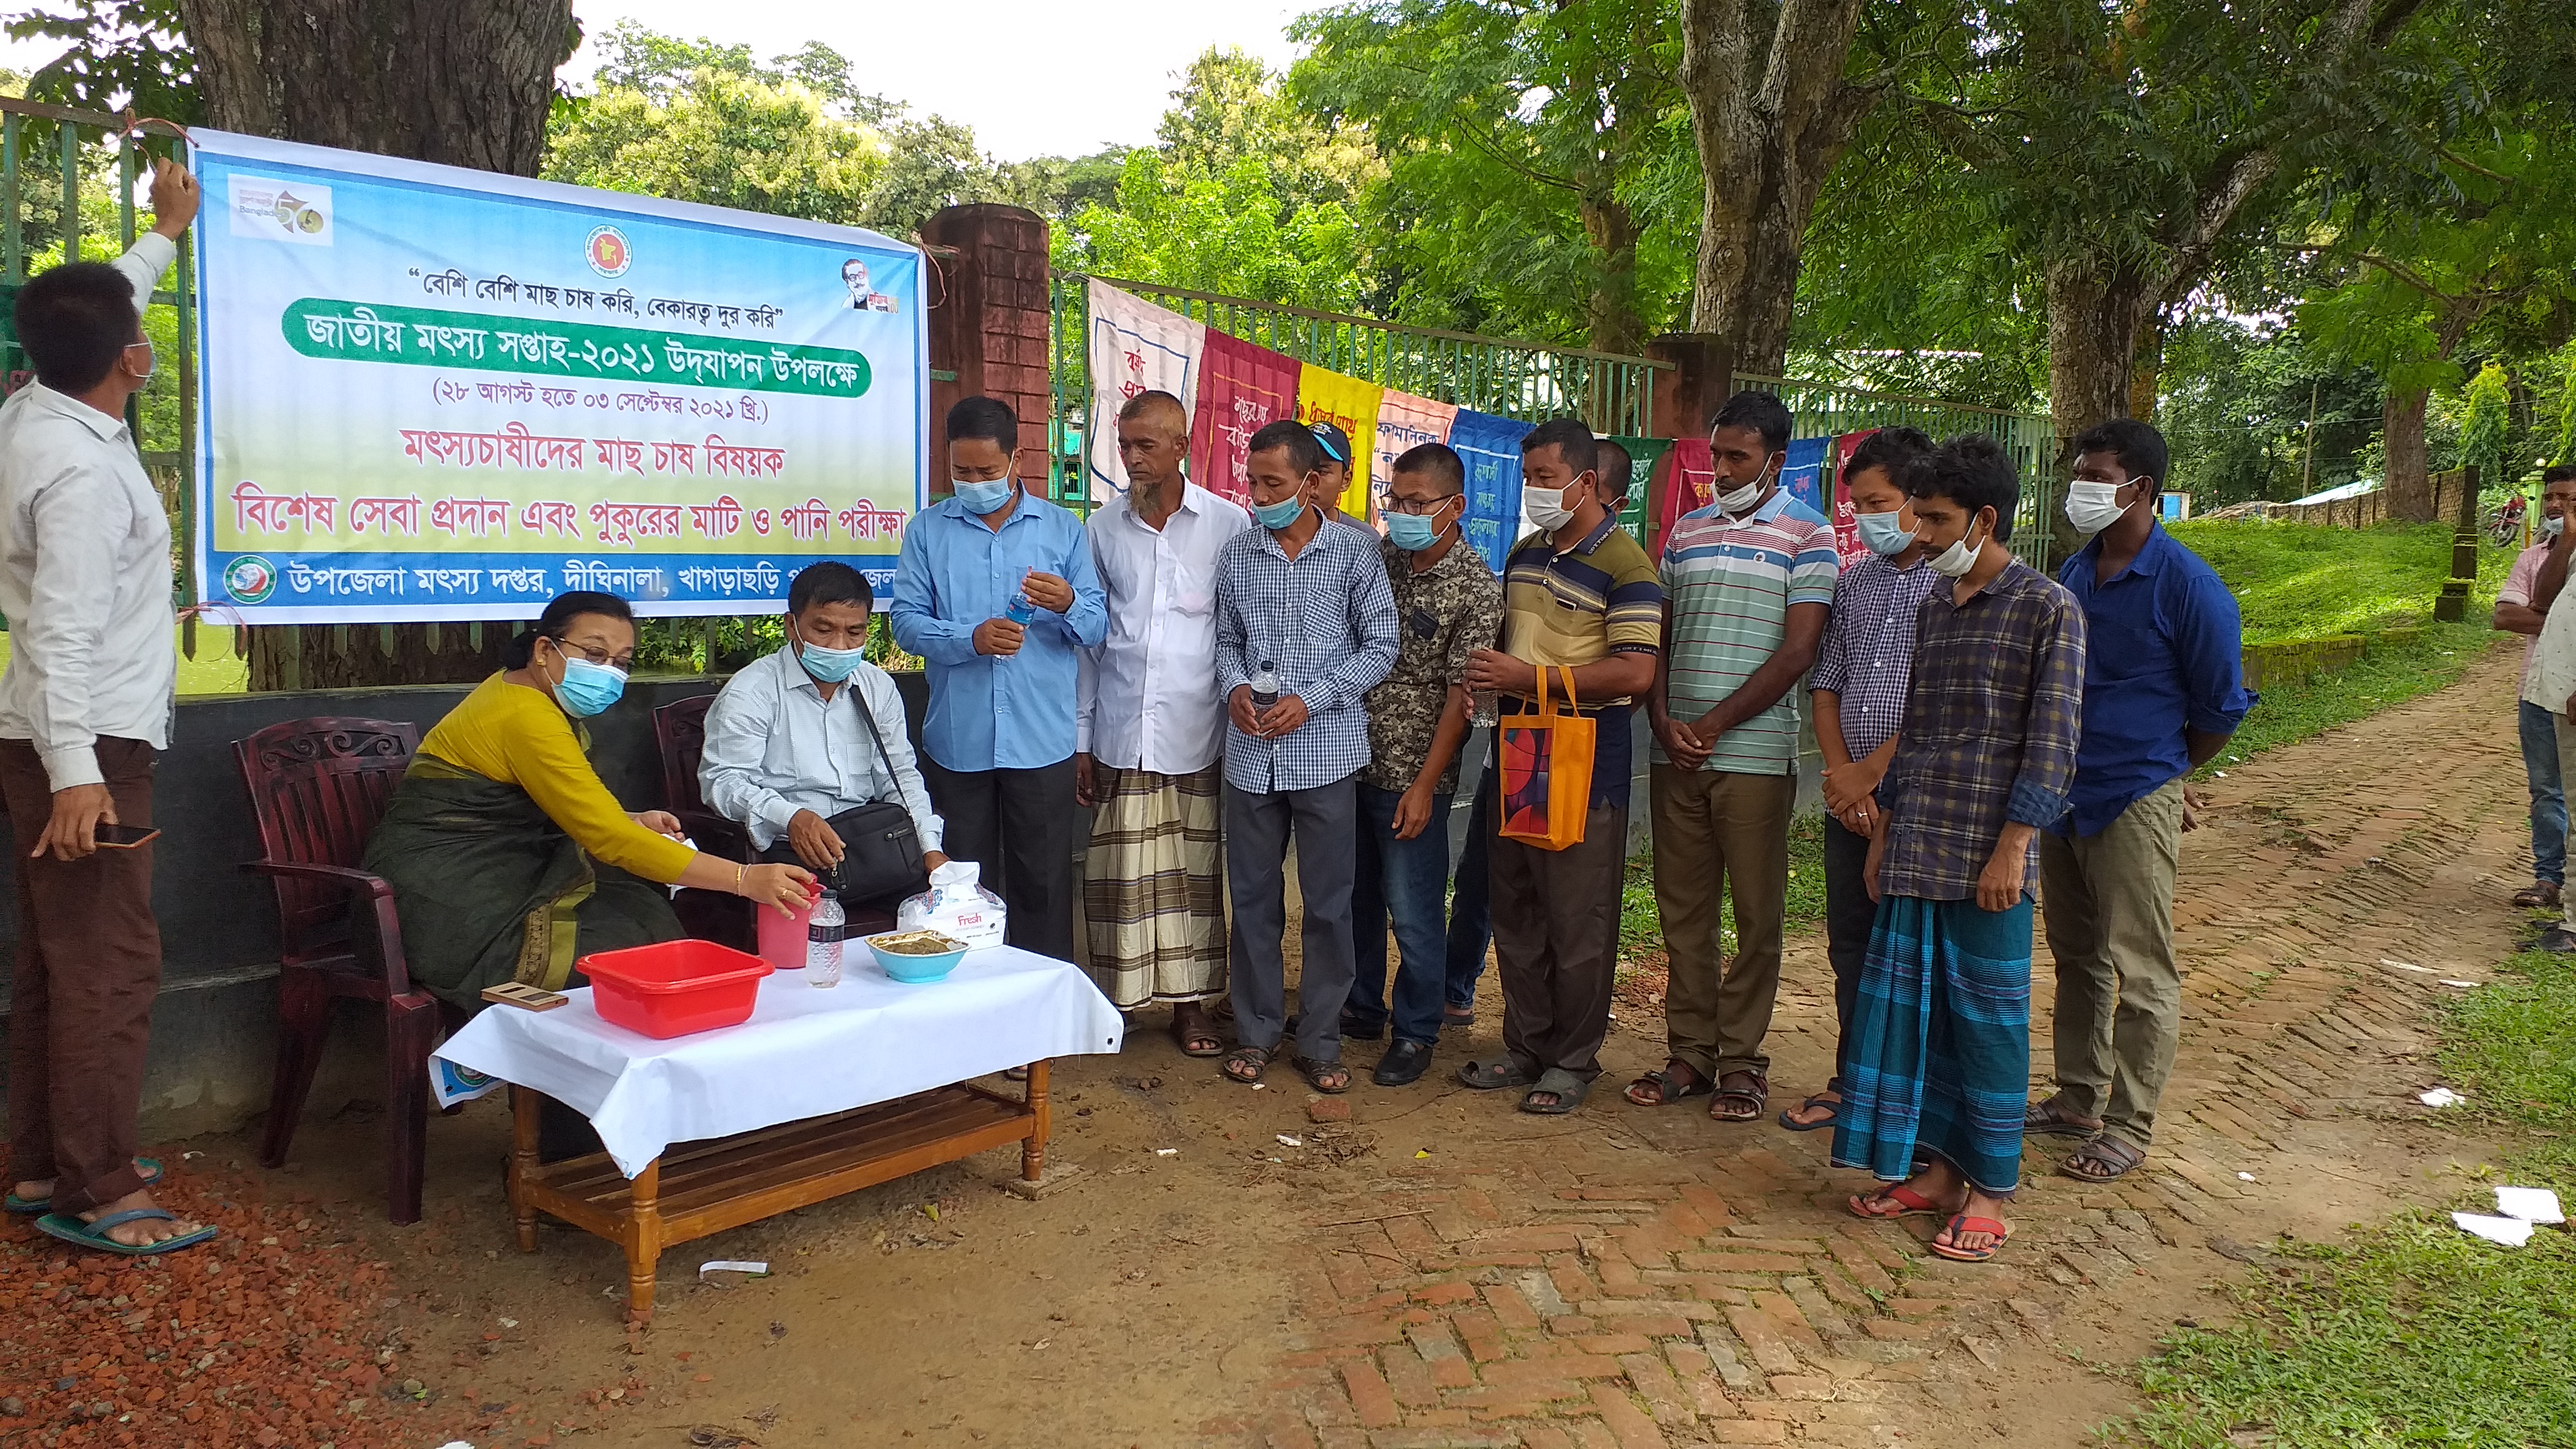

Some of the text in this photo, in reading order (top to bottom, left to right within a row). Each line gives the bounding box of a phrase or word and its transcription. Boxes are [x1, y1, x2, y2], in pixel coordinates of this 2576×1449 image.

[476, 274, 519, 303] বেশি
[524, 281, 559, 309] মাছ
[564, 286, 596, 310] চাষ
[600, 288, 640, 320] করি,
[647, 298, 711, 328] বেকারত্ব
[717, 305, 740, 329] দুর
[303, 306, 407, 354] জাতীয়
[412, 323, 489, 360] মৎস্য
[494, 329, 655, 377] সপ্তাহ-২০২১
[769, 349, 860, 390] উপলক্ষে
[432, 376, 470, 407] (২৮
[476, 378, 535, 406] আগস্ট
[540, 386, 575, 409] হতে
[583, 394, 609, 410] ০৩
[616, 387, 684, 416] সেপ্টেম্বর
[690, 397, 734, 418] ২০২১
[399, 421, 786, 479] মৎস্যচাষীদের মাছ চাষ বিষয়ক
[230, 481, 908, 548] বিশেষ সেবা প্রদান এবং পুকুরের মাটি ও পানি পরীক্ষা
[1588, 532, 1609, 554] COTTON
[287, 560, 409, 597] উপজেলা
[414, 565, 484, 596] মৎস্য
[490, 567, 554, 600] দপ্তর,
[562, 559, 670, 598] দীঘিনালা,
[678, 560, 782, 597] খাগড়াছড়ি
[957, 912, 982, 926] Fresh
